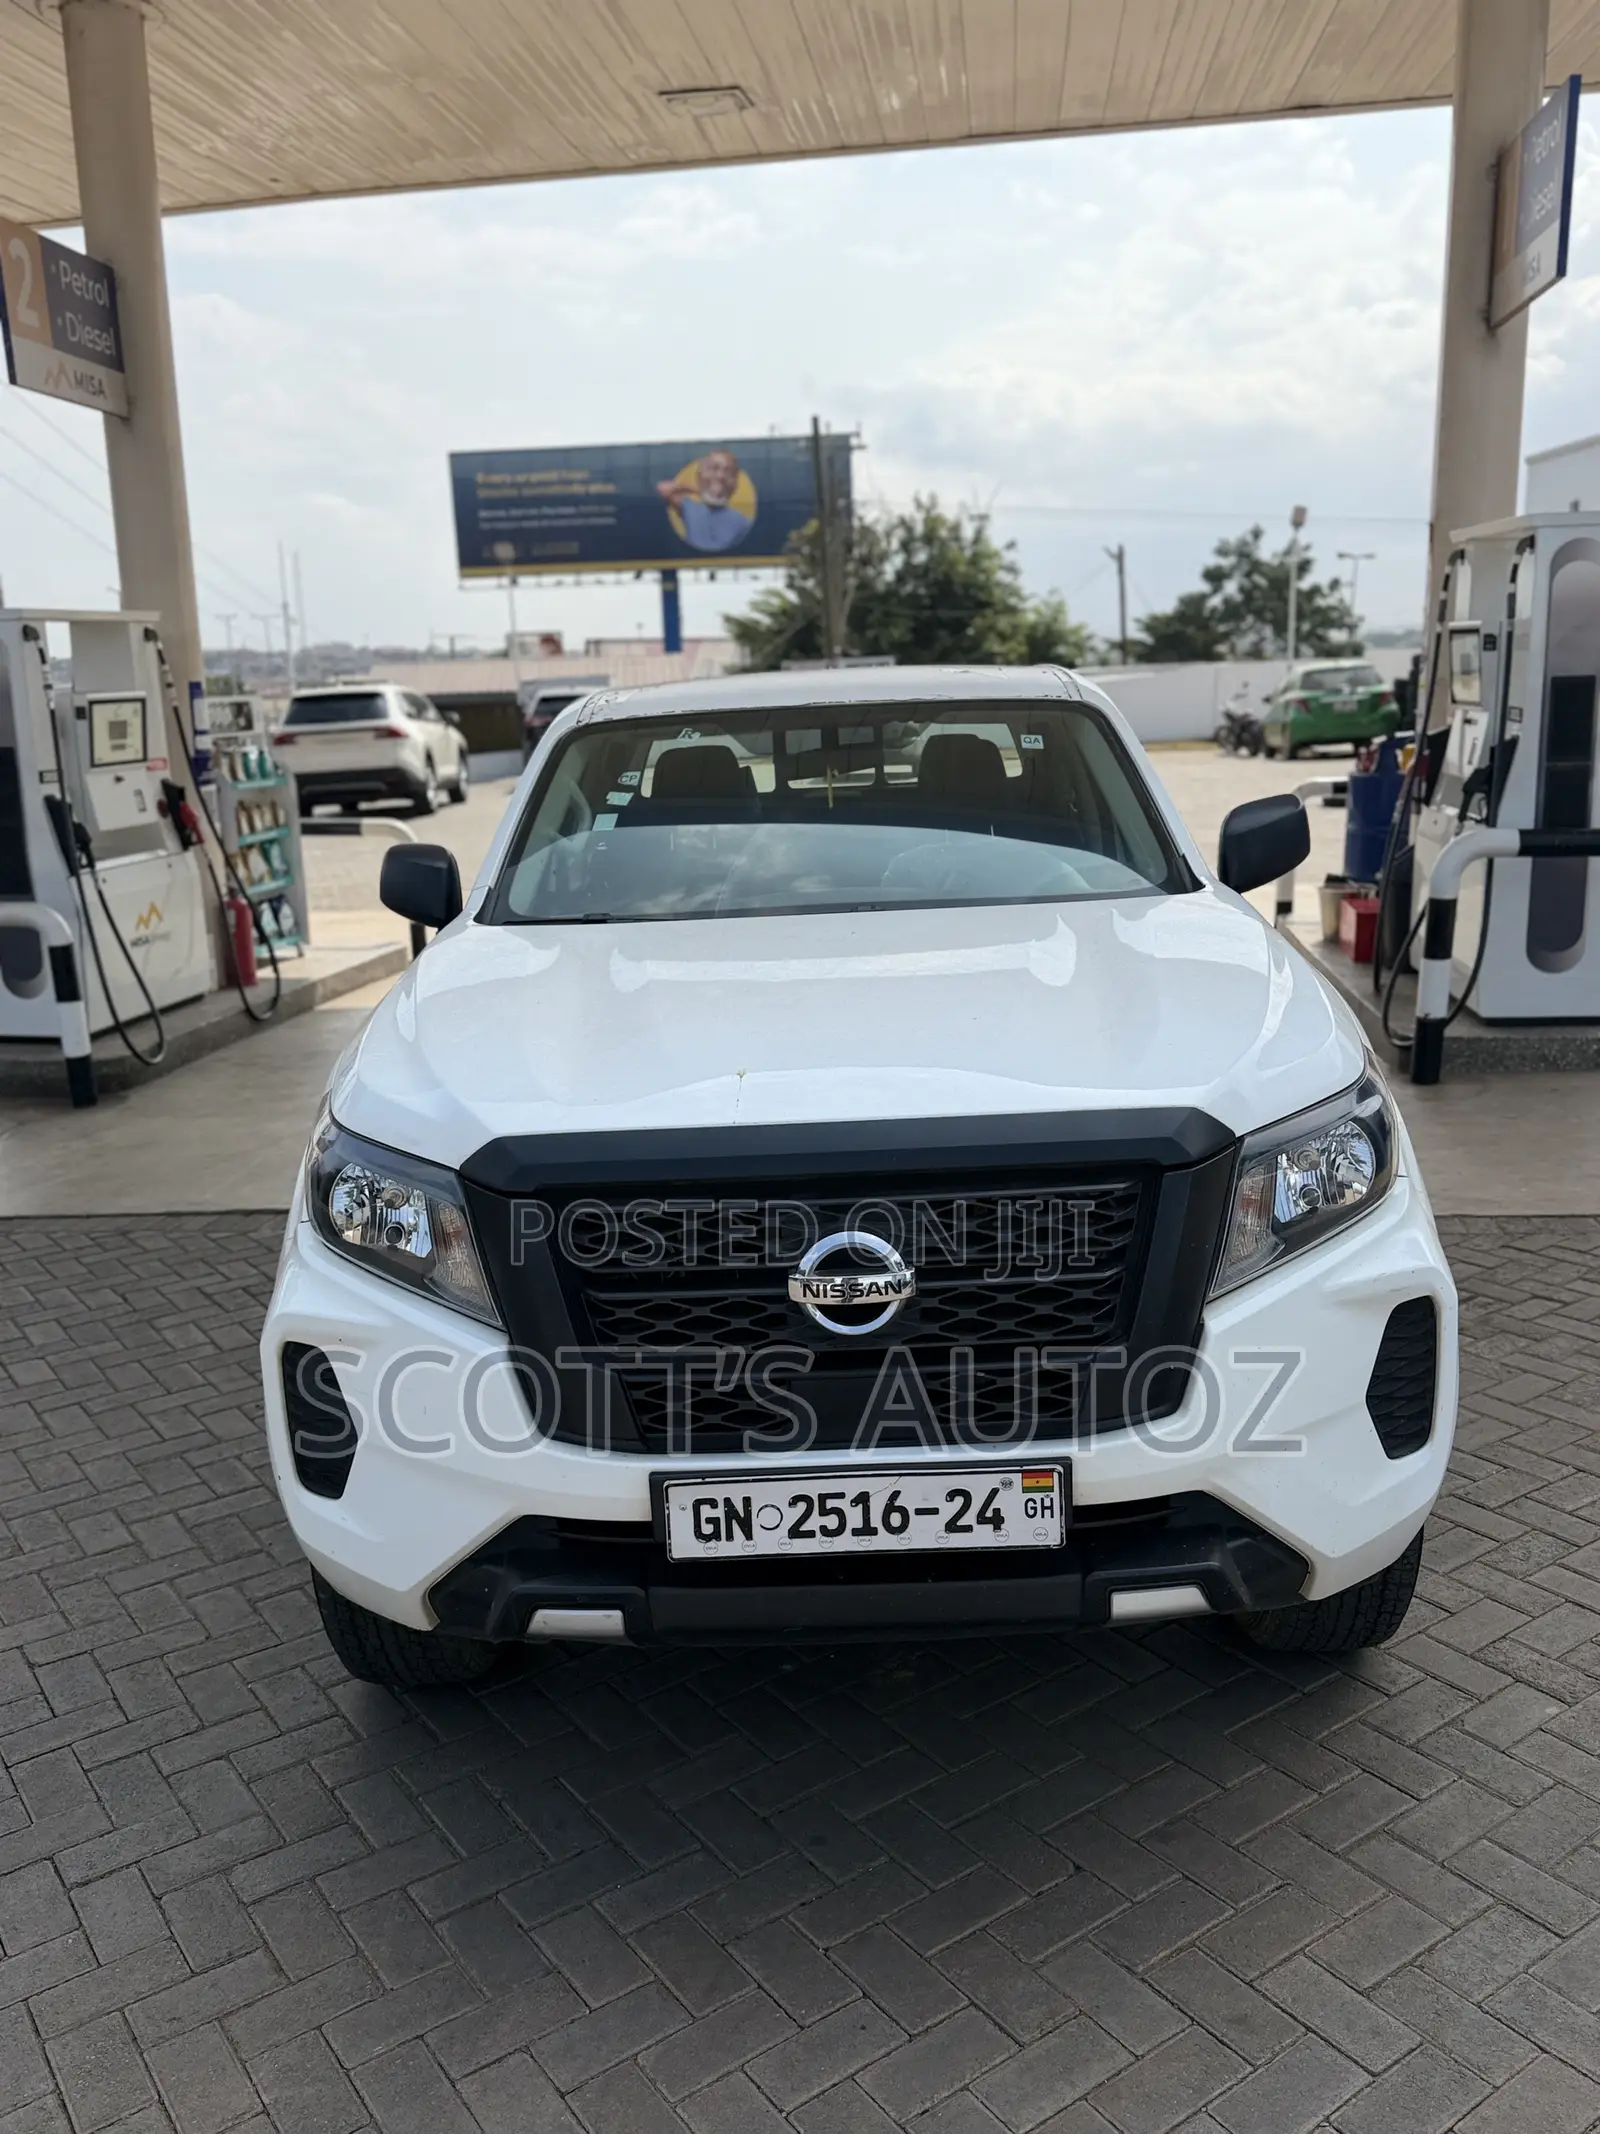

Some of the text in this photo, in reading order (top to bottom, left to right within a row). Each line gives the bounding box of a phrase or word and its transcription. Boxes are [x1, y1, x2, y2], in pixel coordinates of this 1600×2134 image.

[8, 237, 41, 328] 2
[59, 260, 110, 308] Petrol
[65, 311, 117, 356] Diesel
[73, 368, 107, 399] MISA
[1023, 736, 1041, 745] QA
[620, 774, 638, 783] CP
[802, 1280, 903, 1299] NISSAN
[692, 1486, 1005, 1543] GN 2516-24
[1024, 1497, 1054, 1519] GH
